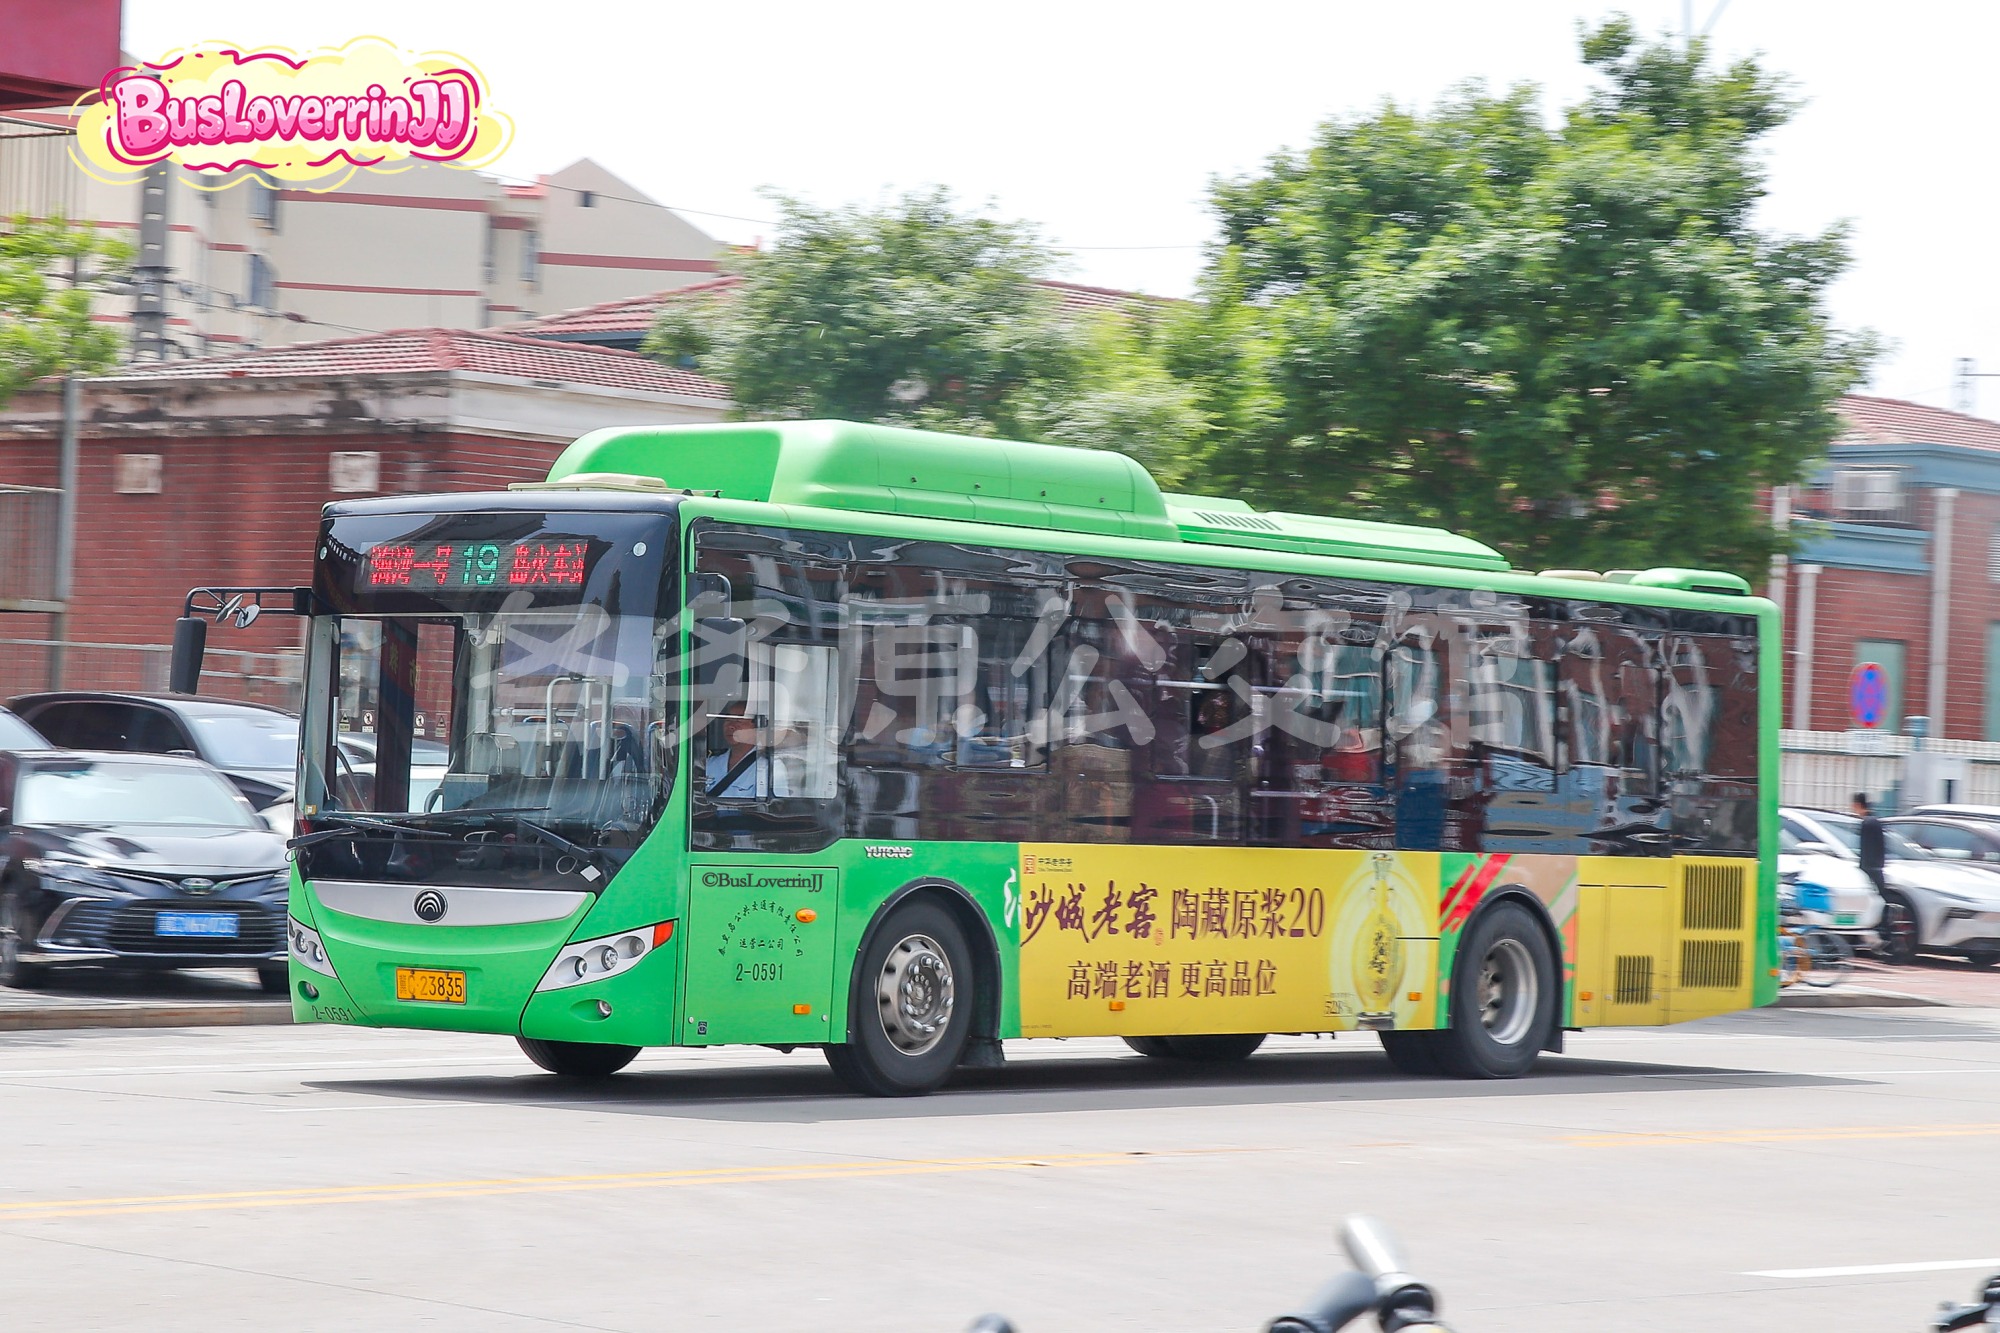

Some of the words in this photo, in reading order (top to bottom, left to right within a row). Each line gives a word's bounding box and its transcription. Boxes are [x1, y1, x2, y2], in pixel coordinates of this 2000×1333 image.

[462, 543, 501, 585] 19
[864, 846, 914, 859] YUTONG
[1170, 887, 1326, 941] 陶藏原浆20
[739, 938, 784, 950] 运营二公司
[735, 963, 784, 982] 2-0591
[1066, 959, 1172, 1000] 高端老酒
[1179, 958, 1279, 998] 更高品位
[311, 1005, 357, 1021] 2-0591
